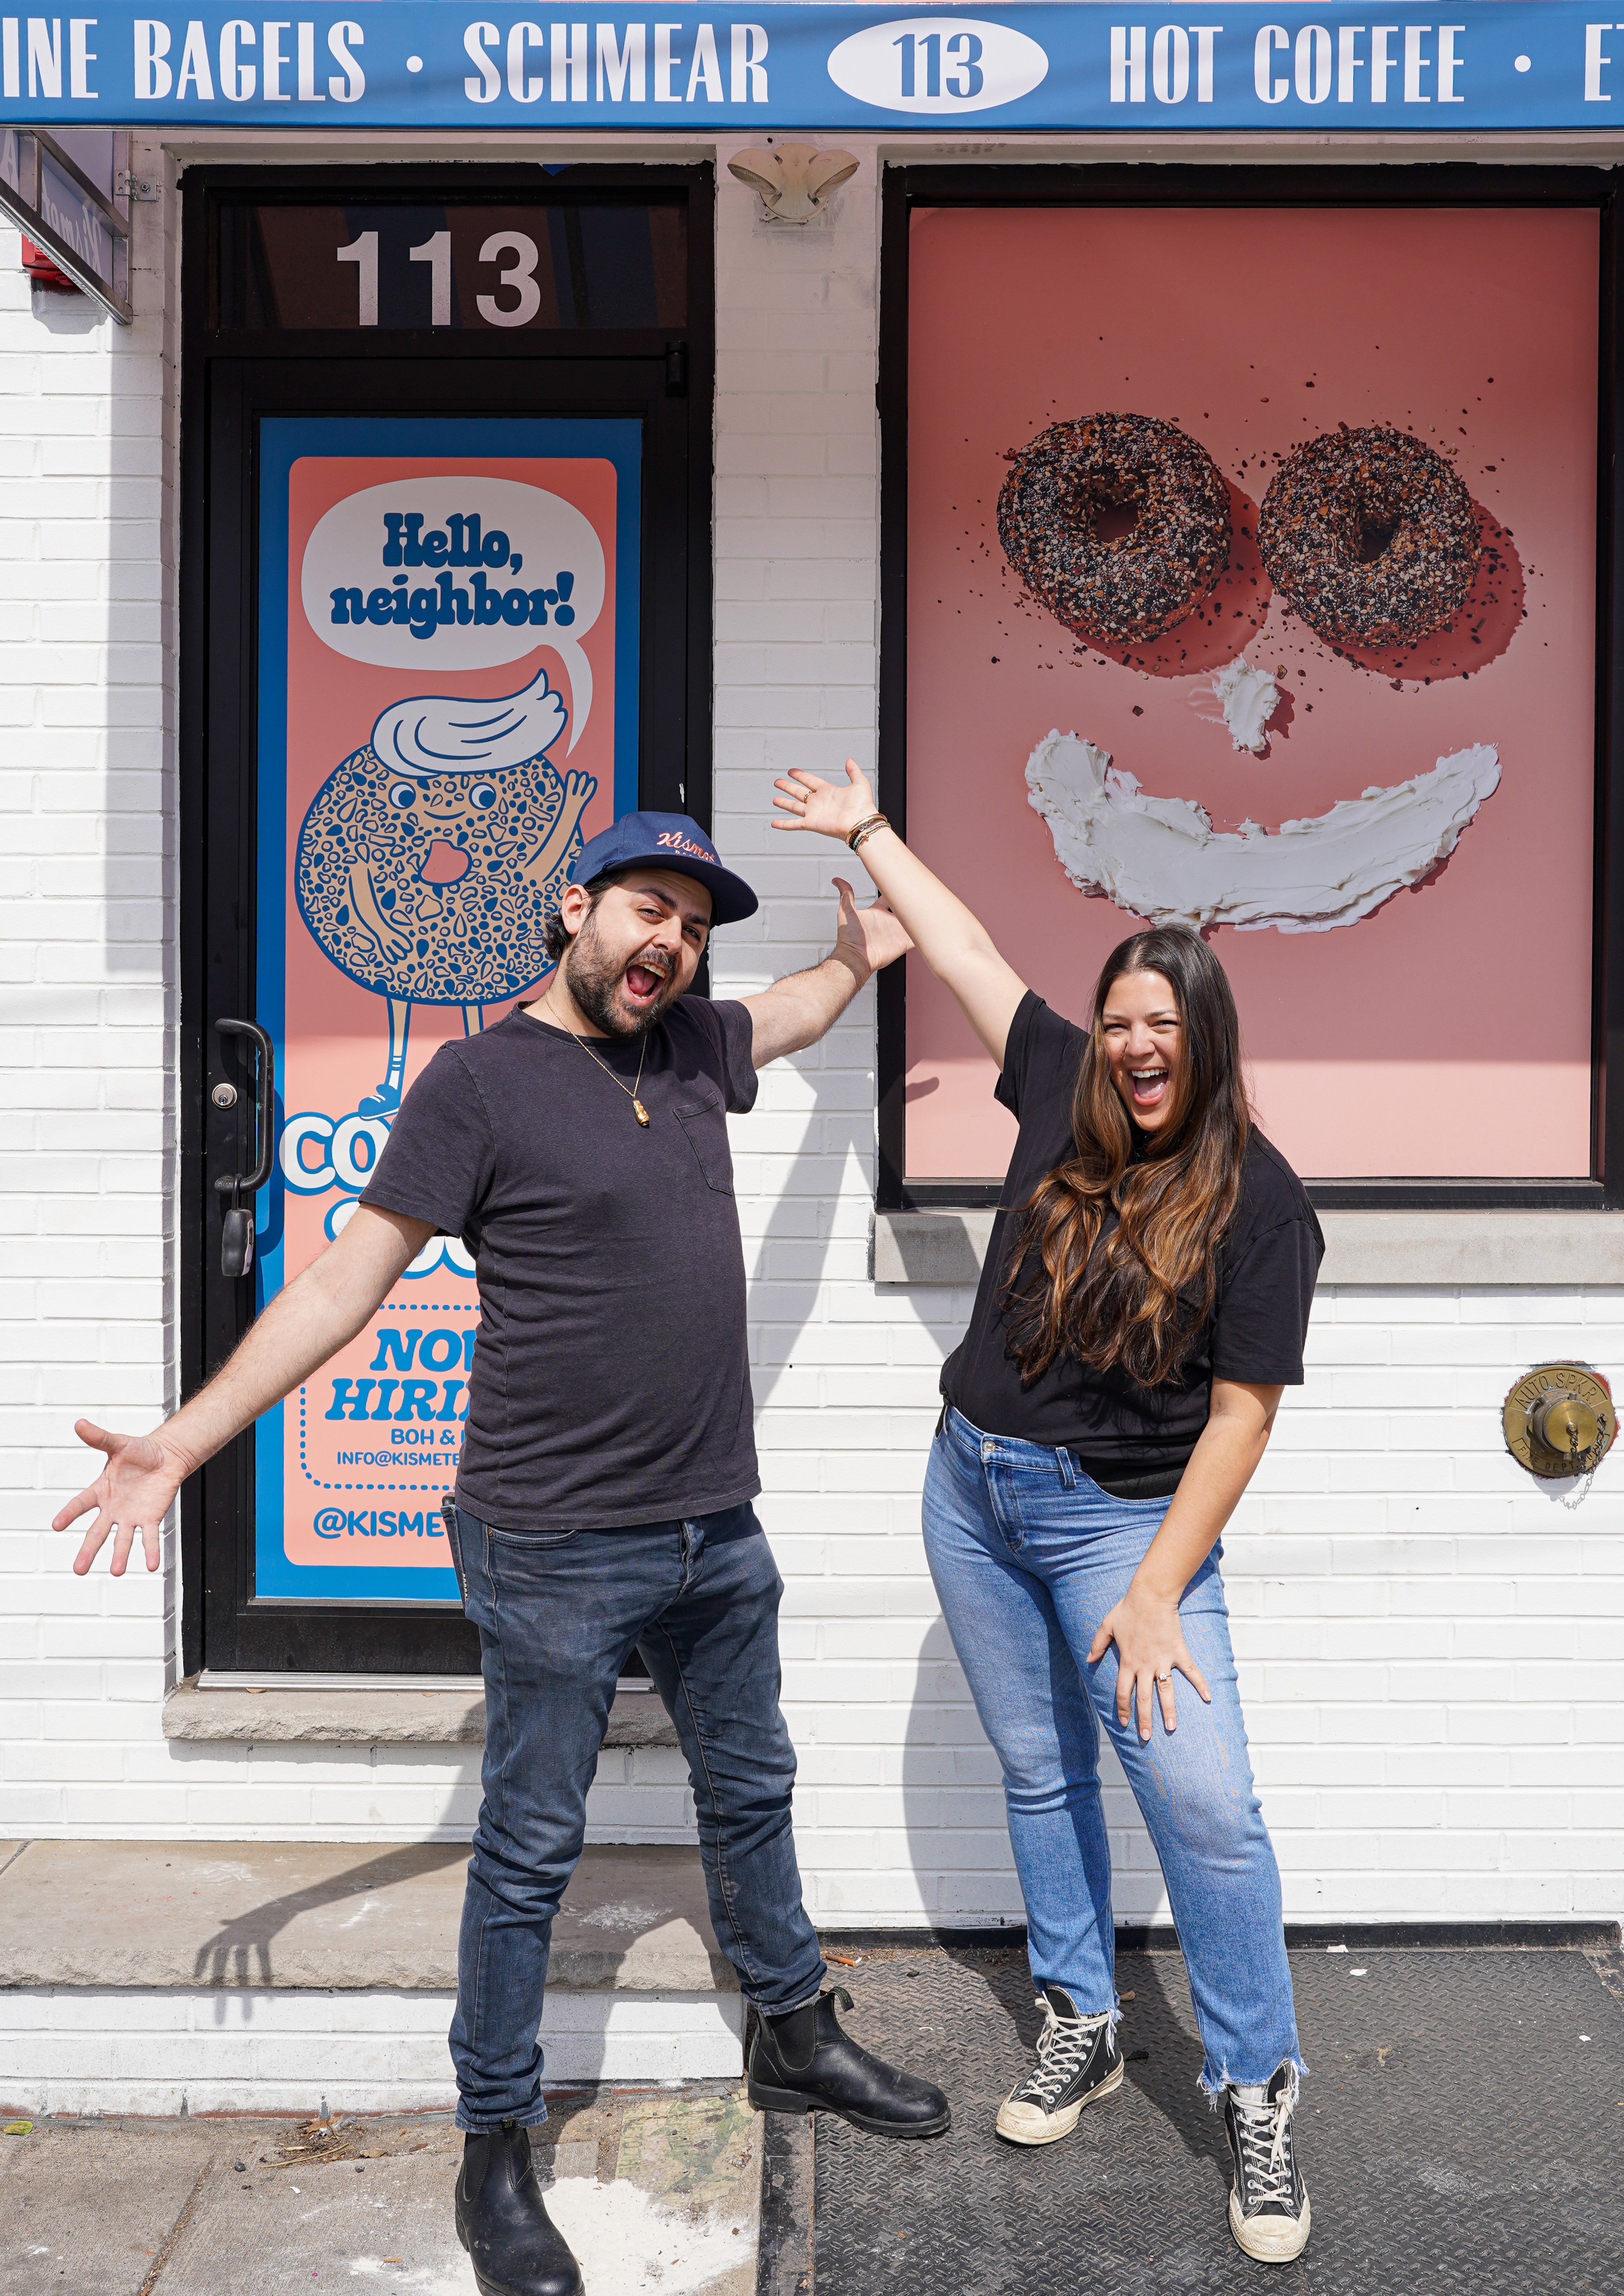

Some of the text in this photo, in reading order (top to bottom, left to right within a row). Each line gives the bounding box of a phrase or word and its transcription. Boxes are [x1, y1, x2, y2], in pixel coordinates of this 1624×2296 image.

[134, 19, 366, 102] BAGELS
[463, 22, 769, 103] SCHMEAR
[892, 33, 984, 98] 113
[1110, 23, 1624, 104] HOT COFFEE E
[337, 231, 541, 326] 113
[383, 513, 522, 575] Hello,
[329, 571, 575, 639] neighbor!
[279, 1112, 396, 1196] CO
[325, 1378, 470, 1422] HIRI
[1515, 1374, 1550, 1409] AUTO
[391, 1429, 435, 1445] BOH
[439, 1429, 455, 1445] &
[314, 1507, 444, 1539] @KISME
